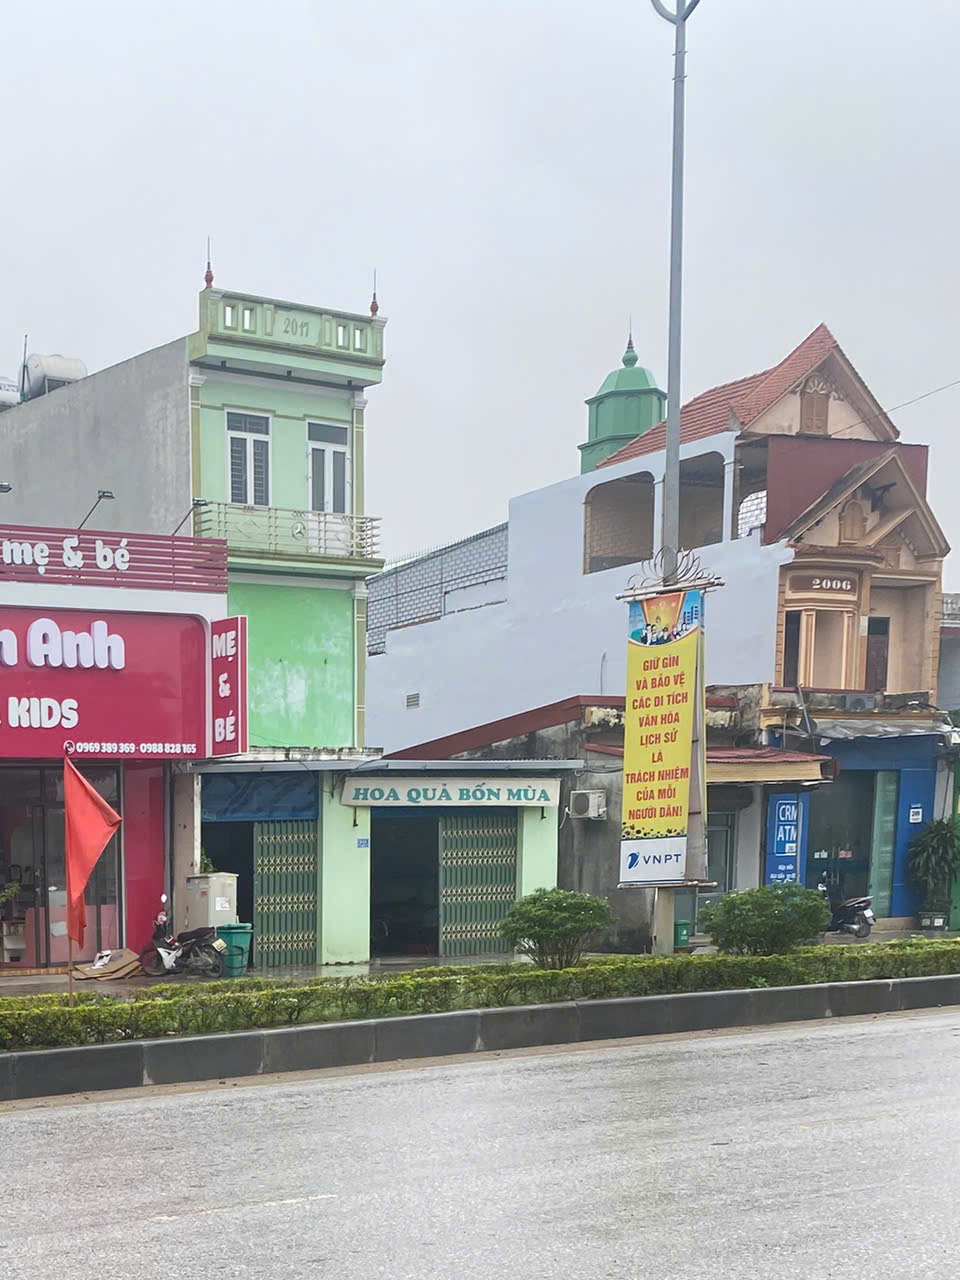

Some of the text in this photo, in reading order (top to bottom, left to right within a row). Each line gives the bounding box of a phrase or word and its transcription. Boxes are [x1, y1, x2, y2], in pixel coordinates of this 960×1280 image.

[283, 317, 310, 337] 2017
[2, 540, 50, 575] mẹ
[62, 536, 85, 568] &
[95, 538, 130, 572] bé
[812, 578, 852, 591] 2006
[26, 618, 125, 670] Anh
[212, 630, 237, 662] MẸ
[662, 655, 679, 668] GÌN
[218, 672, 231, 698] &
[636, 671, 685, 691] VÀ BẢO VỆ
[632, 691, 688, 710] CÁC DI TÍCH
[7, 696, 79, 729] KIDS
[638, 711, 680, 728] VĂN HÓA
[214, 709, 236, 742] BÉ
[640, 733, 661, 749] LỊCH
[651, 751, 663, 764] LÀ
[625, 767, 689, 784] TRÁCH NHIỆM
[352, 782, 551, 803] HOA QUẢ BỐN MÙA
[636, 787, 655, 801] CỦA
[628, 805, 657, 820] NGƯỜI
[642, 853, 682, 865] VNPT
